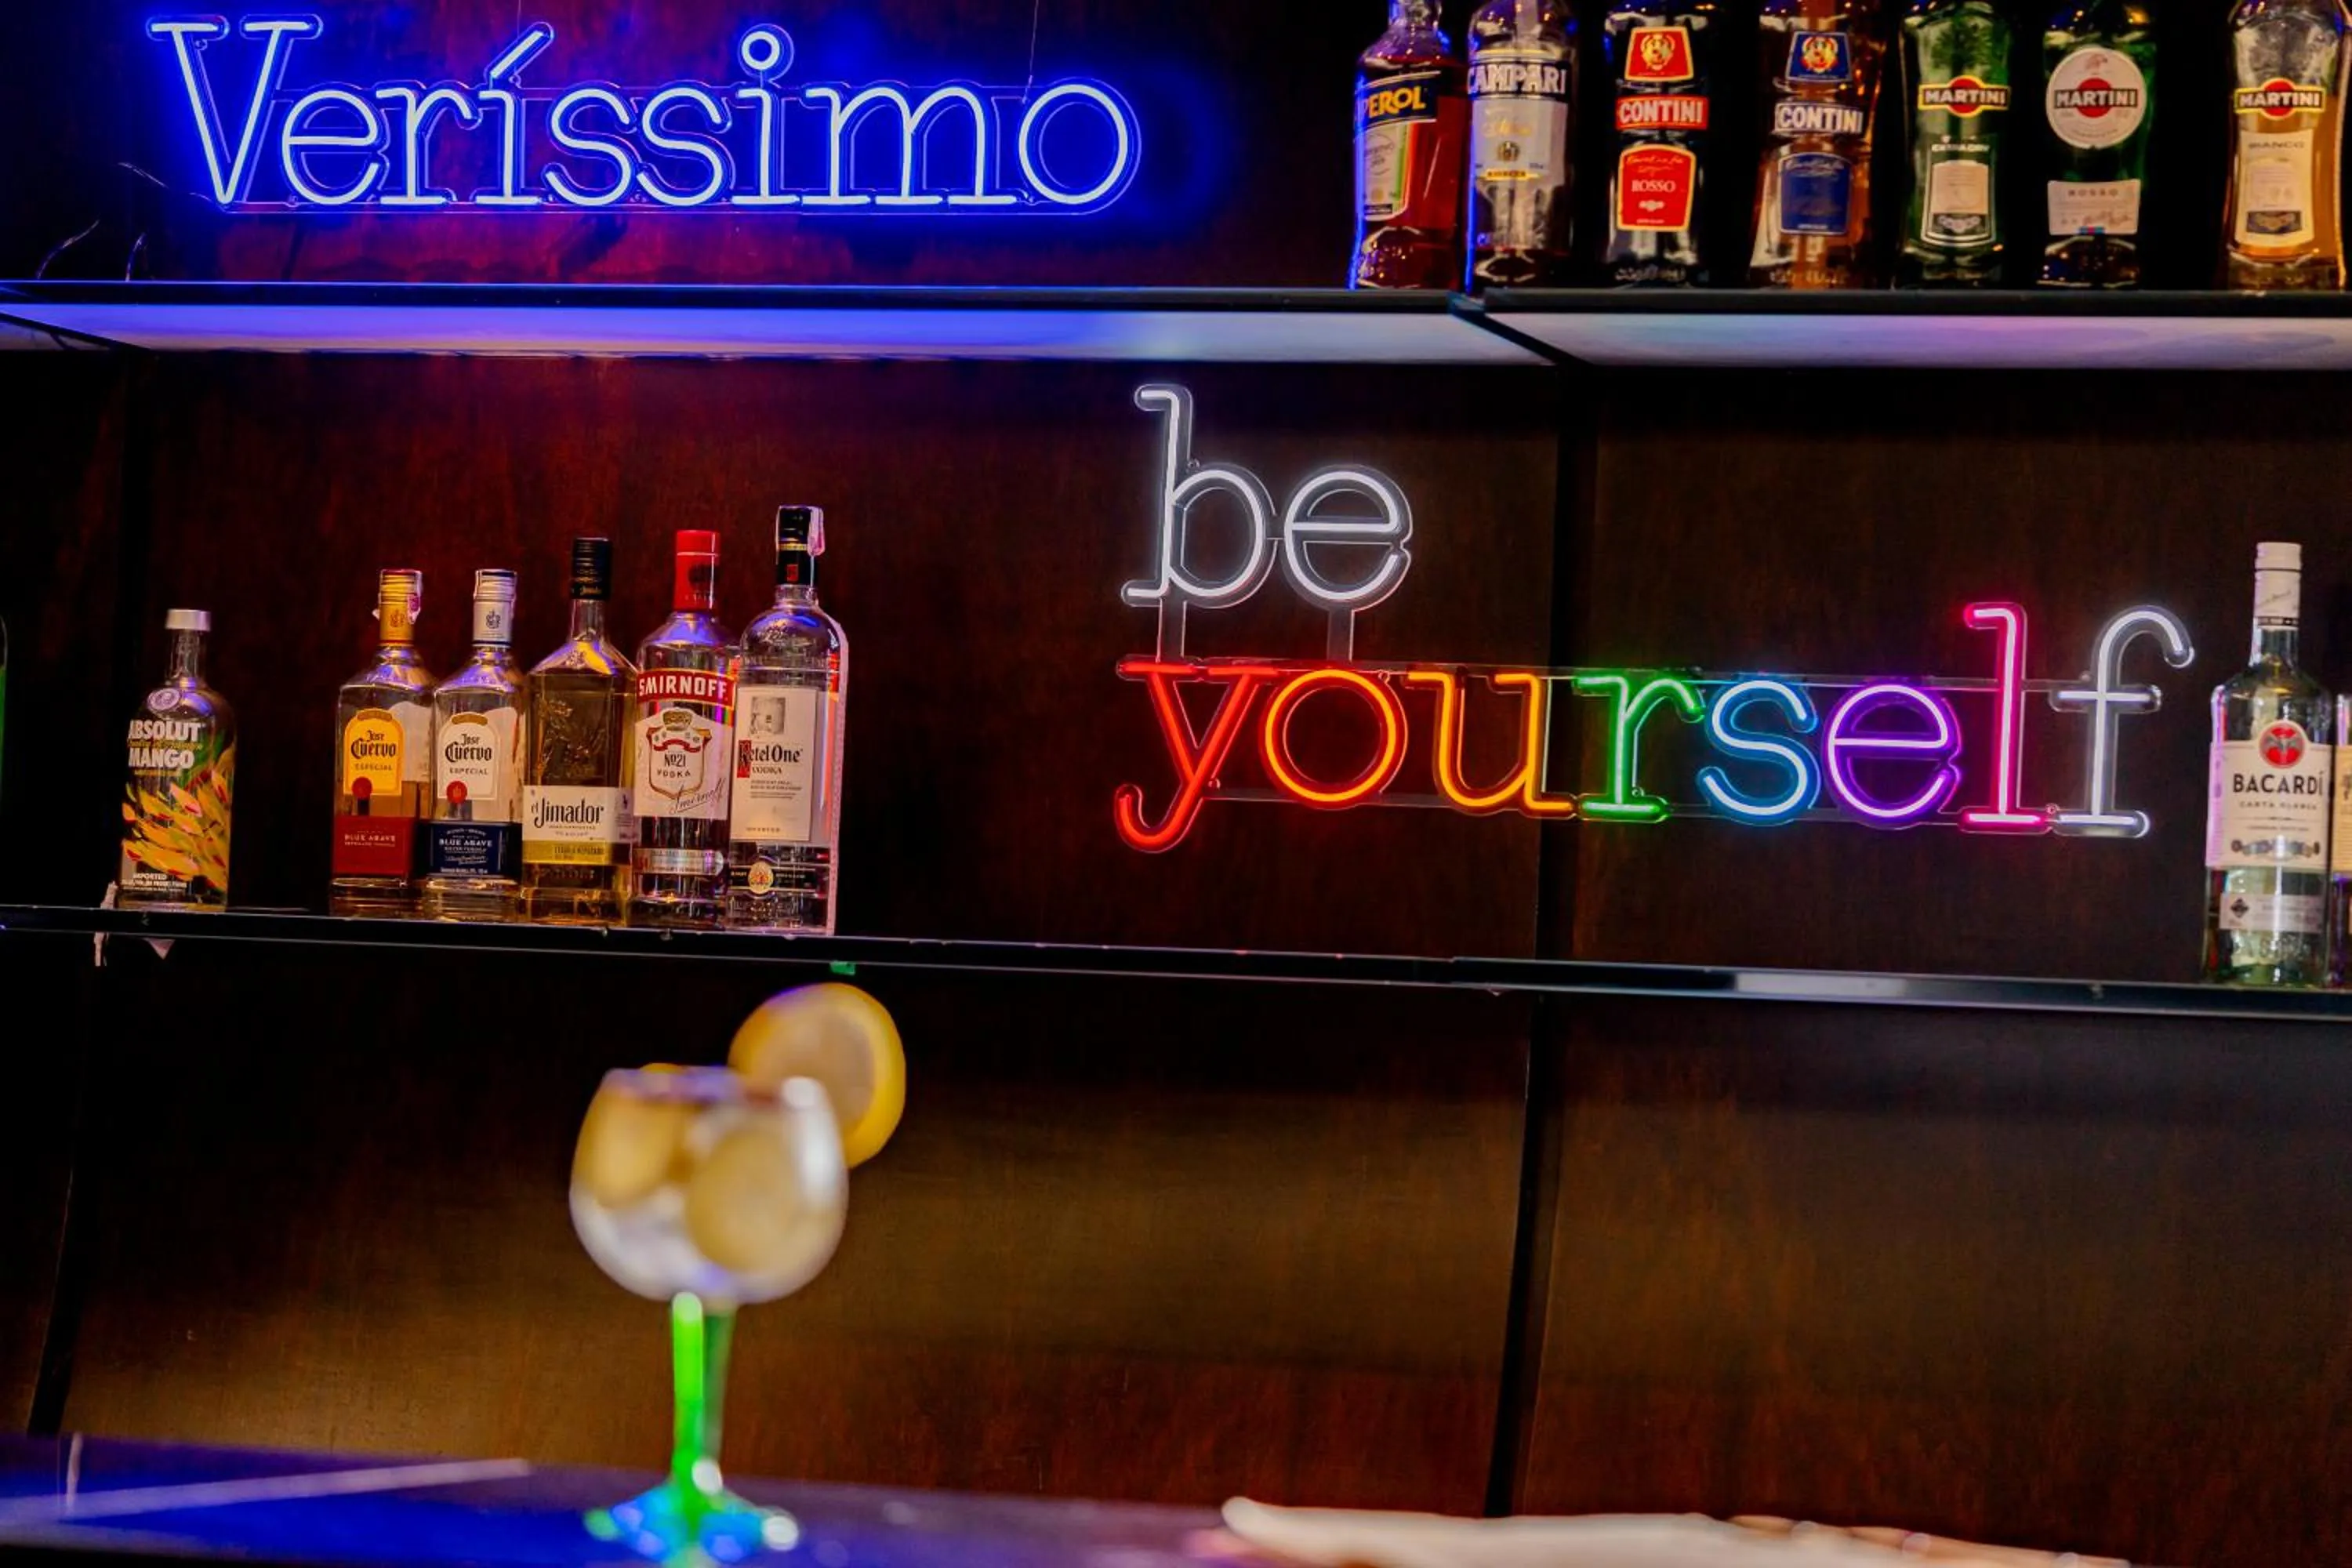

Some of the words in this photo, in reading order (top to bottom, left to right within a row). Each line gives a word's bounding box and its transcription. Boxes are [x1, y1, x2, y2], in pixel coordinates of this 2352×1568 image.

[1468, 64, 1566, 94] CAMPARI
[1924, 89, 2006, 105] MARTINI
[2056, 90, 2136, 107] MARTINI
[2238, 91, 2321, 107] MARTINI
[147, 21, 1137, 207] Veríssimo
[1619, 100, 1704, 124] CONTINI
[1780, 106, 1864, 134] CONTINI
[1631, 180, 1677, 194] ROSSO
[1123, 387, 1411, 608] be
[638, 674, 728, 701] SMIRNOFF
[128, 719, 201, 742] ABSOLUT
[1113, 602, 2194, 854] yourself
[128, 747, 195, 769] MANGO
[350, 737, 396, 760] Cuervo
[445, 742, 492, 763] Cuervo
[771, 744, 800, 763] One
[656, 769, 691, 778] VODKA
[2233, 771, 2324, 797] BACARDÍ
[534, 797, 604, 829] Jimador
[438, 838, 462, 847] BLUE
